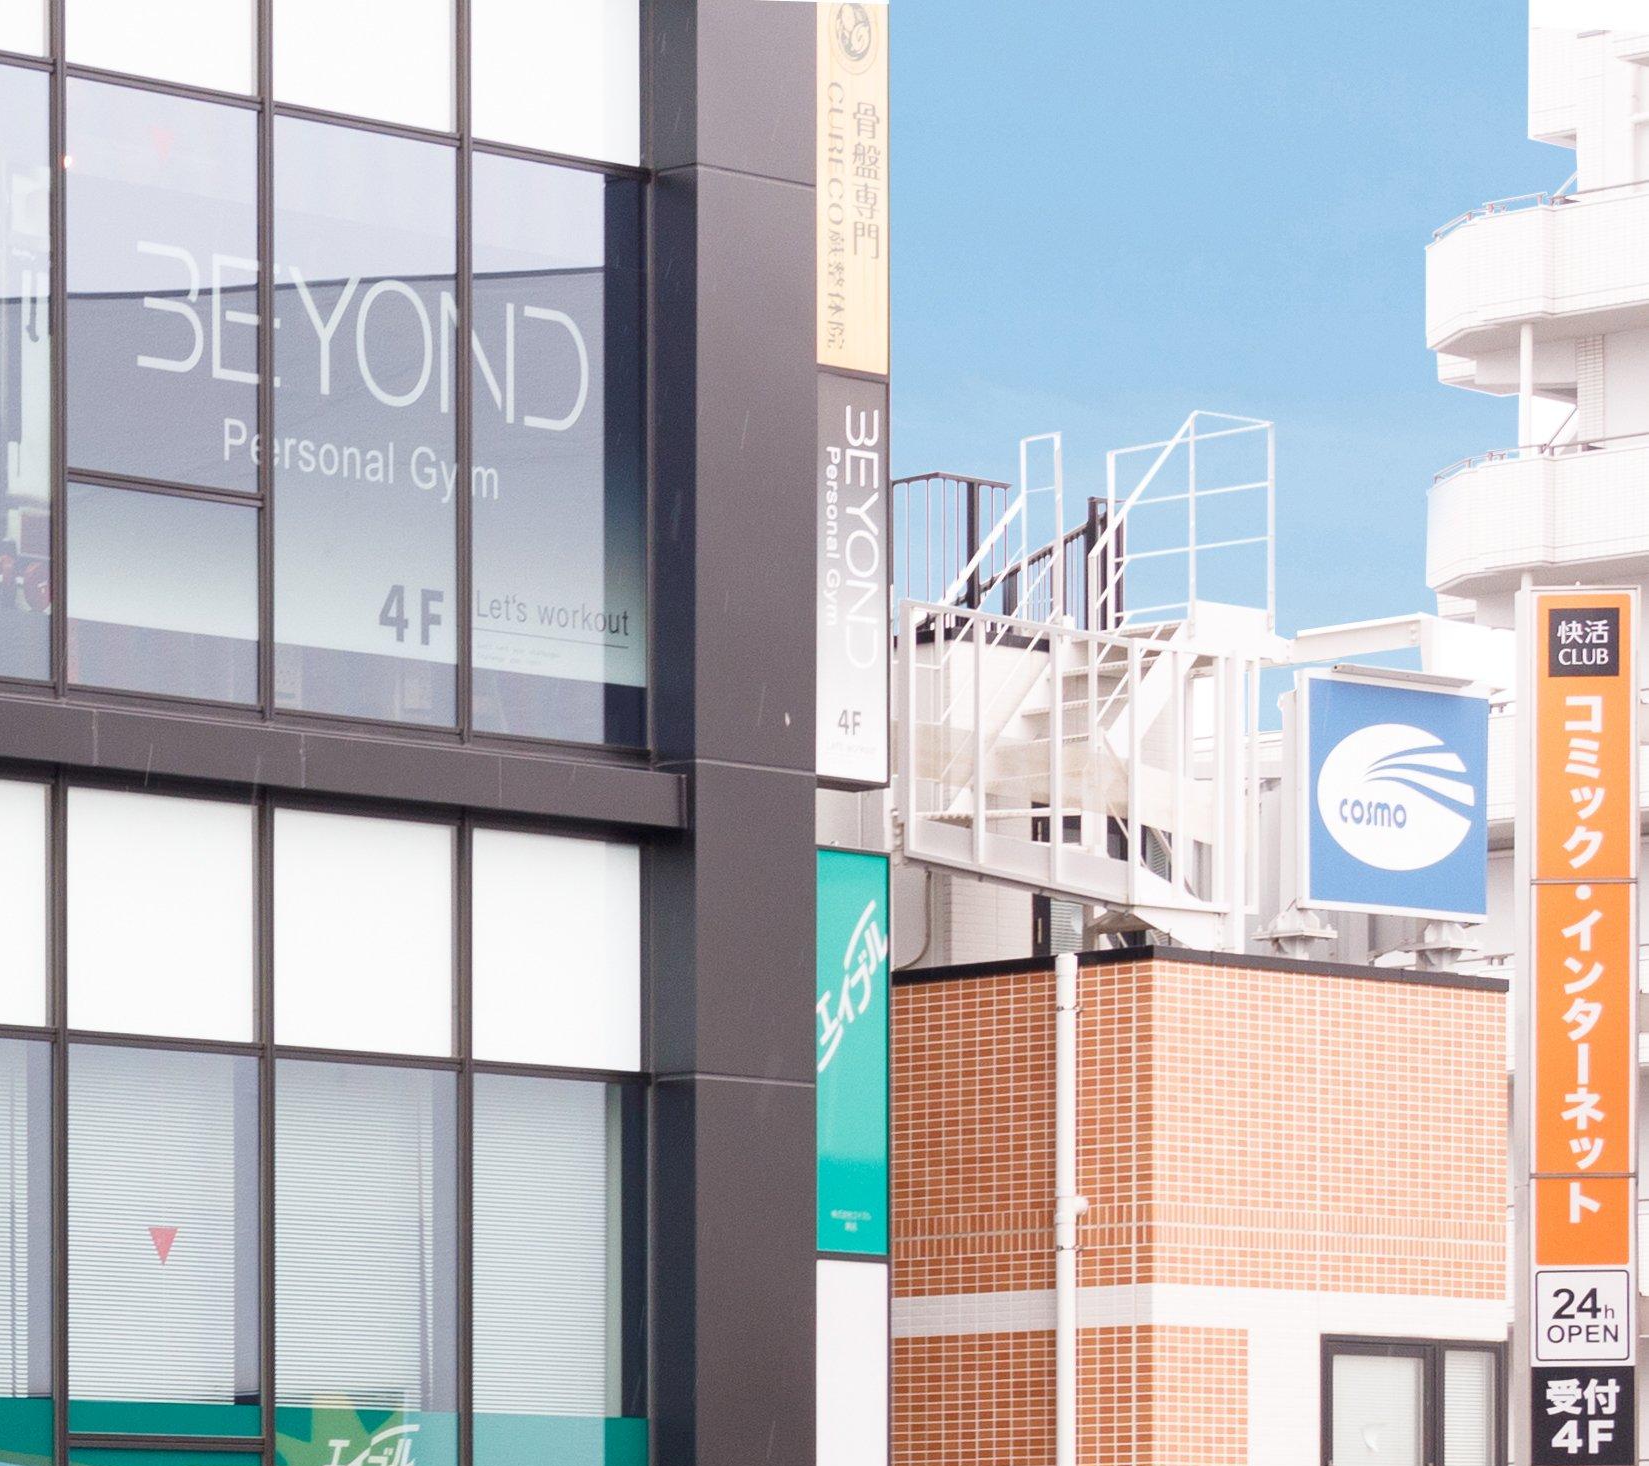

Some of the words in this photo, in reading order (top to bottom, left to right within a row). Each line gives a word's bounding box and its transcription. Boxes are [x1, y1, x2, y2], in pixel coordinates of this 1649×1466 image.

[852, 101, 881, 260] 骨盤専門
[223, 417, 395, 486] Personal
[409, 446, 500, 504] Gym
[824, 445, 841, 561] Personal
[378, 583, 446, 646] 4F
[824, 568, 838, 628] Gym
[536, 599, 630, 637] workout
[1557, 619, 1610, 645] 快活
[1558, 647, 1610, 665] CLUB
[837, 710, 862, 738] 4F
[1339, 798, 1407, 830] cosmo
[1562, 695, 1607, 1224] コミック・インターネット
[1547, 1324, 1620, 1344] OPEN
[1545, 1378, 1621, 1416] 受付
[1551, 1419, 1615, 1455] 4F
